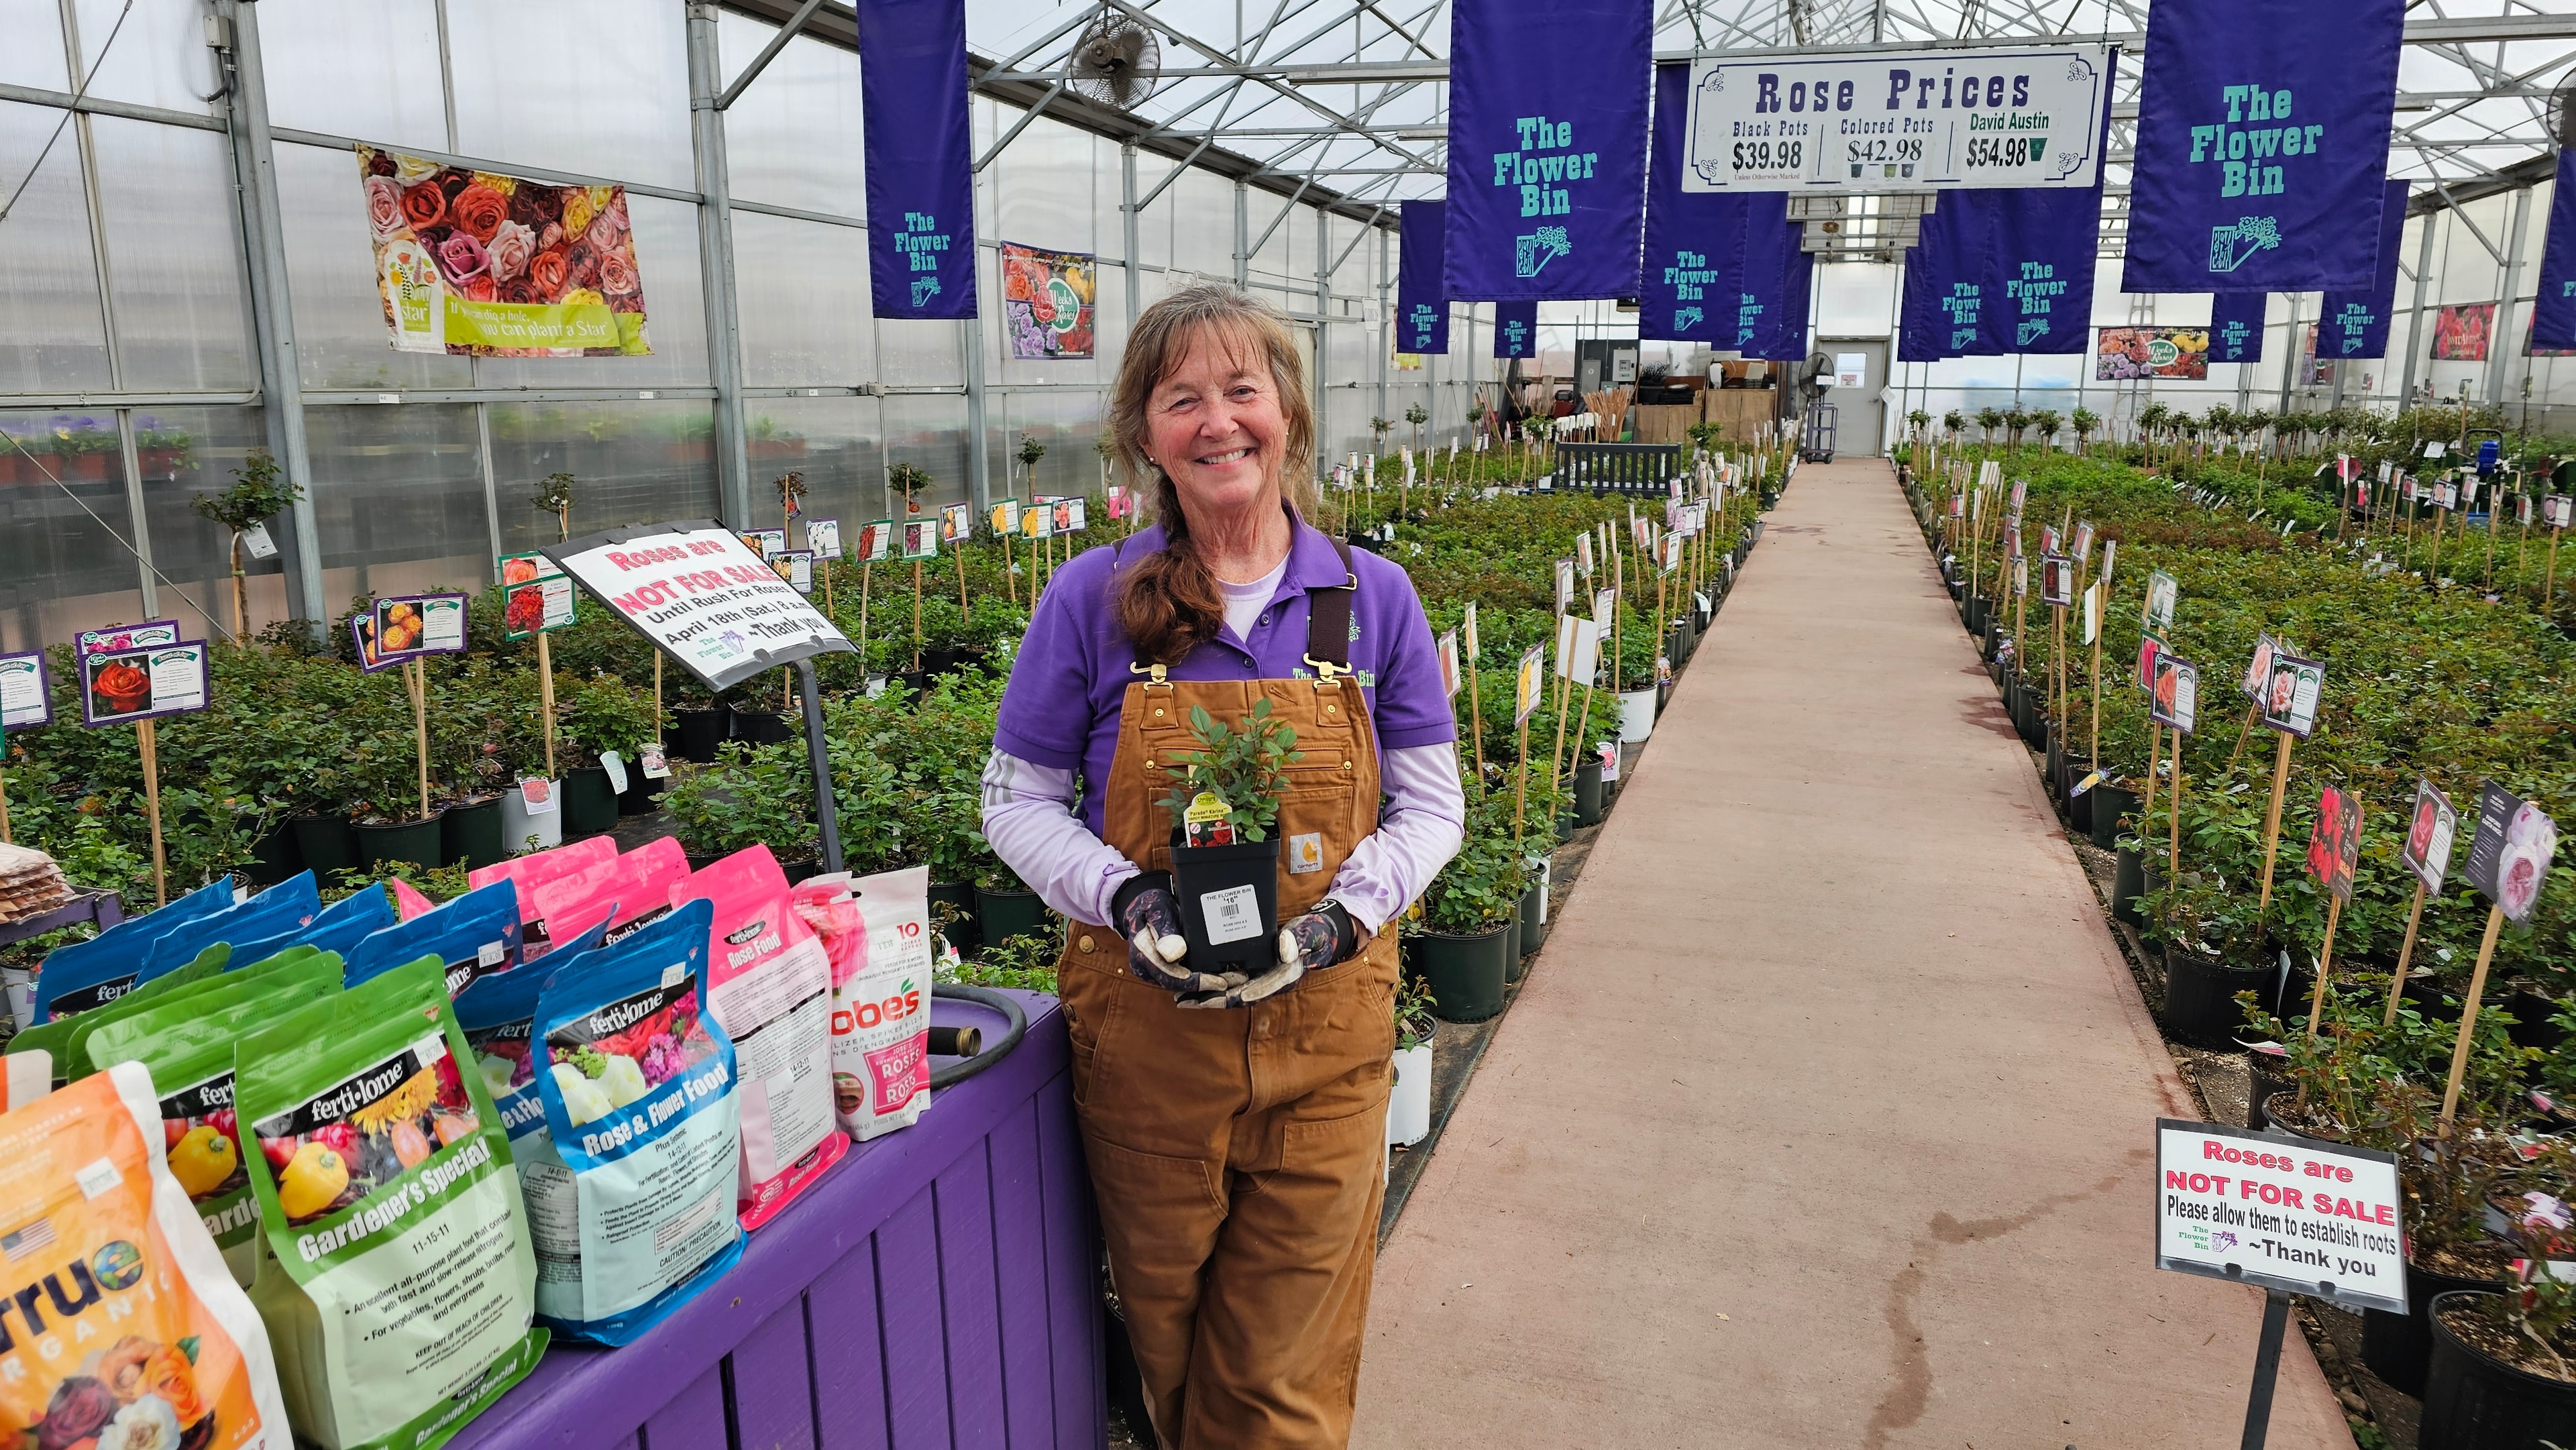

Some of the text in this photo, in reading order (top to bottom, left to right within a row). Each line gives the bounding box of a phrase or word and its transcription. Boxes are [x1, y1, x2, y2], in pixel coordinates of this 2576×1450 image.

[1756, 67, 2031, 113] Rose Prices
[2223, 84, 2292, 123] The
[1733, 120, 1809, 137] Black Pots
[1841, 117, 1934, 135] Colored Pots
[1970, 111, 2049, 131] David Austin
[1517, 116, 1572, 151] The
[2190, 123, 2323, 163] Flower
[1732, 140, 1803, 172] $39.98
[1847, 139, 1923, 164] $42.98
[1966, 137, 2027, 172] $54.98
[1493, 152, 1597, 186] Flower
[1754, 173, 1778, 181] Otherwise
[2221, 160, 2284, 198] Bin
[1520, 183, 1570, 217] Bin
[905, 212, 934, 232] The
[894, 233, 950, 252] Flower
[910, 252, 937, 271] Bin
[1677, 251, 1706, 268] The
[1664, 268, 1718, 284] Flower
[2021, 262, 2053, 280] The
[1049, 289, 1072, 308] Weeks
[1677, 284, 1703, 300] Bin
[1742, 293, 1755, 304] he
[1953, 282, 1979, 296] The
[2007, 280, 2067, 298] Flower
[1056, 304, 1075, 324] Roses
[1416, 304, 1432, 314] The
[1942, 297, 1981, 312] Flowe
[2021, 296, 2051, 315] Bin
[2346, 303, 2367, 315] The
[1410, 313, 1438, 323] Flower
[1417, 322, 1432, 331] Bin
[1954, 311, 1977, 325] Bin
[2228, 321, 2244, 330] The
[2336, 314, 2375, 325] Flower
[502, 320, 607, 339] can plant a Star
[1504, 328, 1527, 336] Flower
[1510, 334, 1522, 342] Bin
[2221, 329, 2250, 338] Flower
[2345, 324, 2363, 335] Bin
[2147, 344, 2173, 355] Weeks
[2228, 336, 2242, 345] Bin
[2149, 352, 2173, 363] Roses
[605, 539, 726, 573] Roses are
[611, 564, 782, 616] NOT FOR SALE
[646, 584, 790, 624] Until Rush For Roses
[663, 619, 708, 645] April
[707, 611, 743, 626] 18th
[741, 601, 782, 620] (Sat.)
[777, 601, 790, 610] 8
[748, 616, 827, 639] ~Thank you
[699, 636, 716, 646] The
[696, 645, 724, 659] Flower
[718, 651, 734, 661] Bin
[1293, 668, 1375, 687] The Bin
[1218, 890, 1241, 898] FLOWER
[897, 922, 920, 940] 10
[727, 932, 782, 970] Rose Food
[871, 1025, 902, 1039] SPIKES
[790, 1057, 810, 1074] 14-12-11
[881, 1048, 919, 1078] ROSES
[582, 1062, 729, 1158] Rose & Flower Food
[889, 1115, 898, 1123] NET
[655, 1128, 687, 1153] Plus Systemic
[668, 1143, 686, 1160] 14-12-11
[2204, 1140, 2354, 1183] Roses are
[297, 1182, 426, 1264] Gardener's
[421, 1136, 492, 1195] Special
[2166, 1170, 2395, 1227] NOT FOR SALE
[689, 1220, 721, 1249] PRECAUTION
[2167, 1194, 2396, 1256] Please allow them to establish roots
[2192, 1225, 2209, 1234] The
[412, 1223, 450, 1256] 11-15-11
[2178, 1231, 2209, 1242] Flower
[2194, 1241, 2209, 1250] Bin
[2249, 1238, 2377, 1277] ~Thank you
[354, 1227, 488, 1314] An excellent all-purpose plant food that
[381, 1231, 504, 1314] both fast and slow-release nitrogen
[372, 1250, 505, 1341] For vegetables, flowers, shrubs, bulbs,
[433, 1280, 485, 1322] and evergreens
[1, 1270, 170, 1384] RGANIC
[415, 1293, 503, 1359] KEEP OUT REACH CHILDREN
